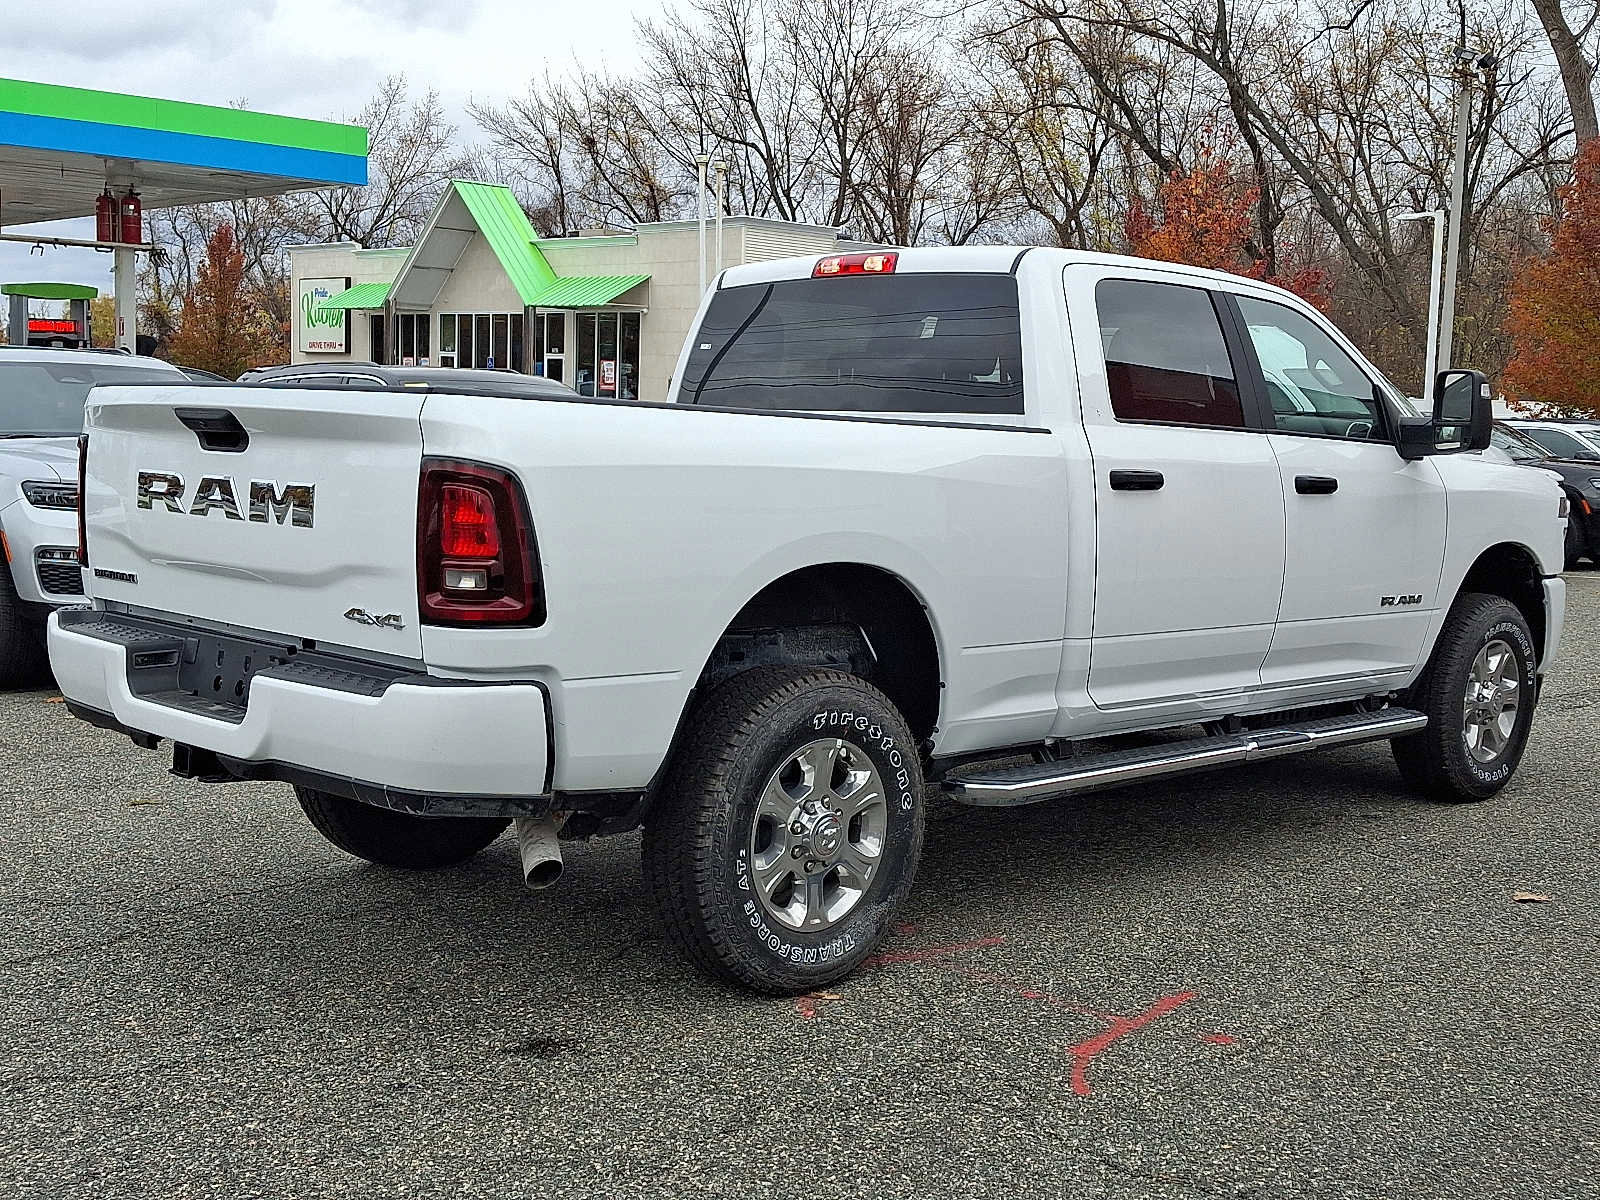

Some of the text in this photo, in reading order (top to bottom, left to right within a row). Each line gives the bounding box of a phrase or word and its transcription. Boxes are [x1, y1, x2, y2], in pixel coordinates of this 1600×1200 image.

[314, 287, 328, 298] Pride
[308, 341, 337, 349] DRIVE THRU
[136, 470, 316, 529] RAM
[1380, 594, 1423, 608] RAM
[813, 710, 913, 810] Firestone
[743, 899, 856, 963] TRANSFORCE
